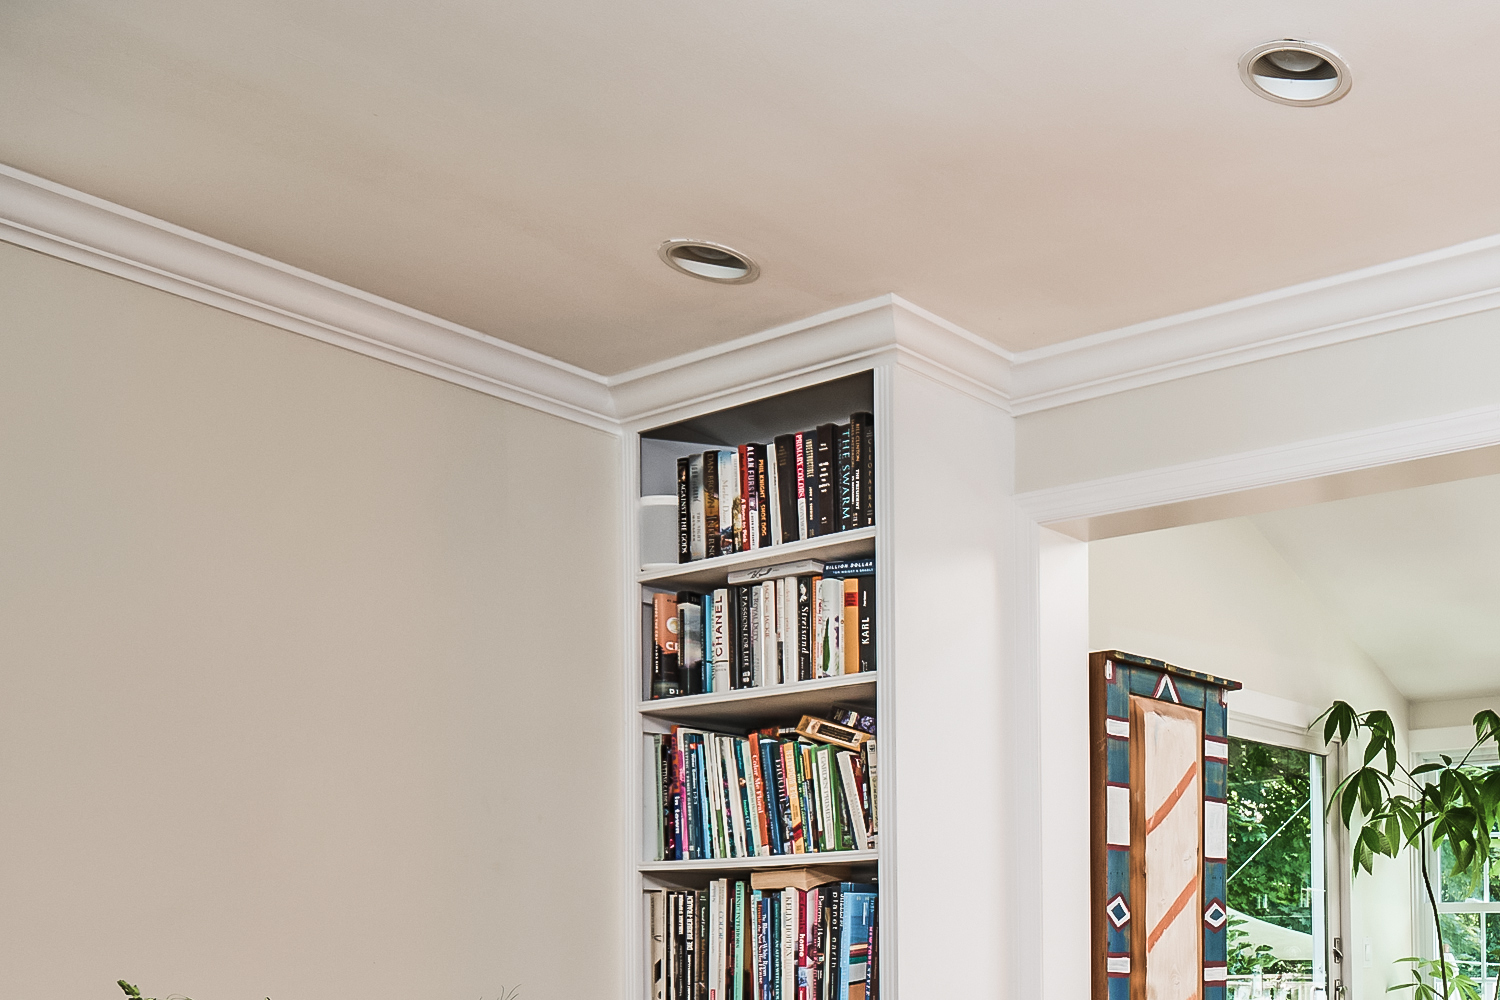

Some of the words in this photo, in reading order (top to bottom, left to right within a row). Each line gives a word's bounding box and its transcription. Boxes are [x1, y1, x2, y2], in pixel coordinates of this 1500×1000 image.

[842, 428, 851, 459] THE
[842, 465, 851, 519] SWARM
[680, 532, 688, 554] GODS
[714, 595, 723, 657] CHANEL
[800, 606, 810, 654] Streisand
[861, 617, 870, 645] KARL
[752, 754, 760, 775] Color
[753, 777, 761, 788] Me
[755, 790, 764, 814] Floral
